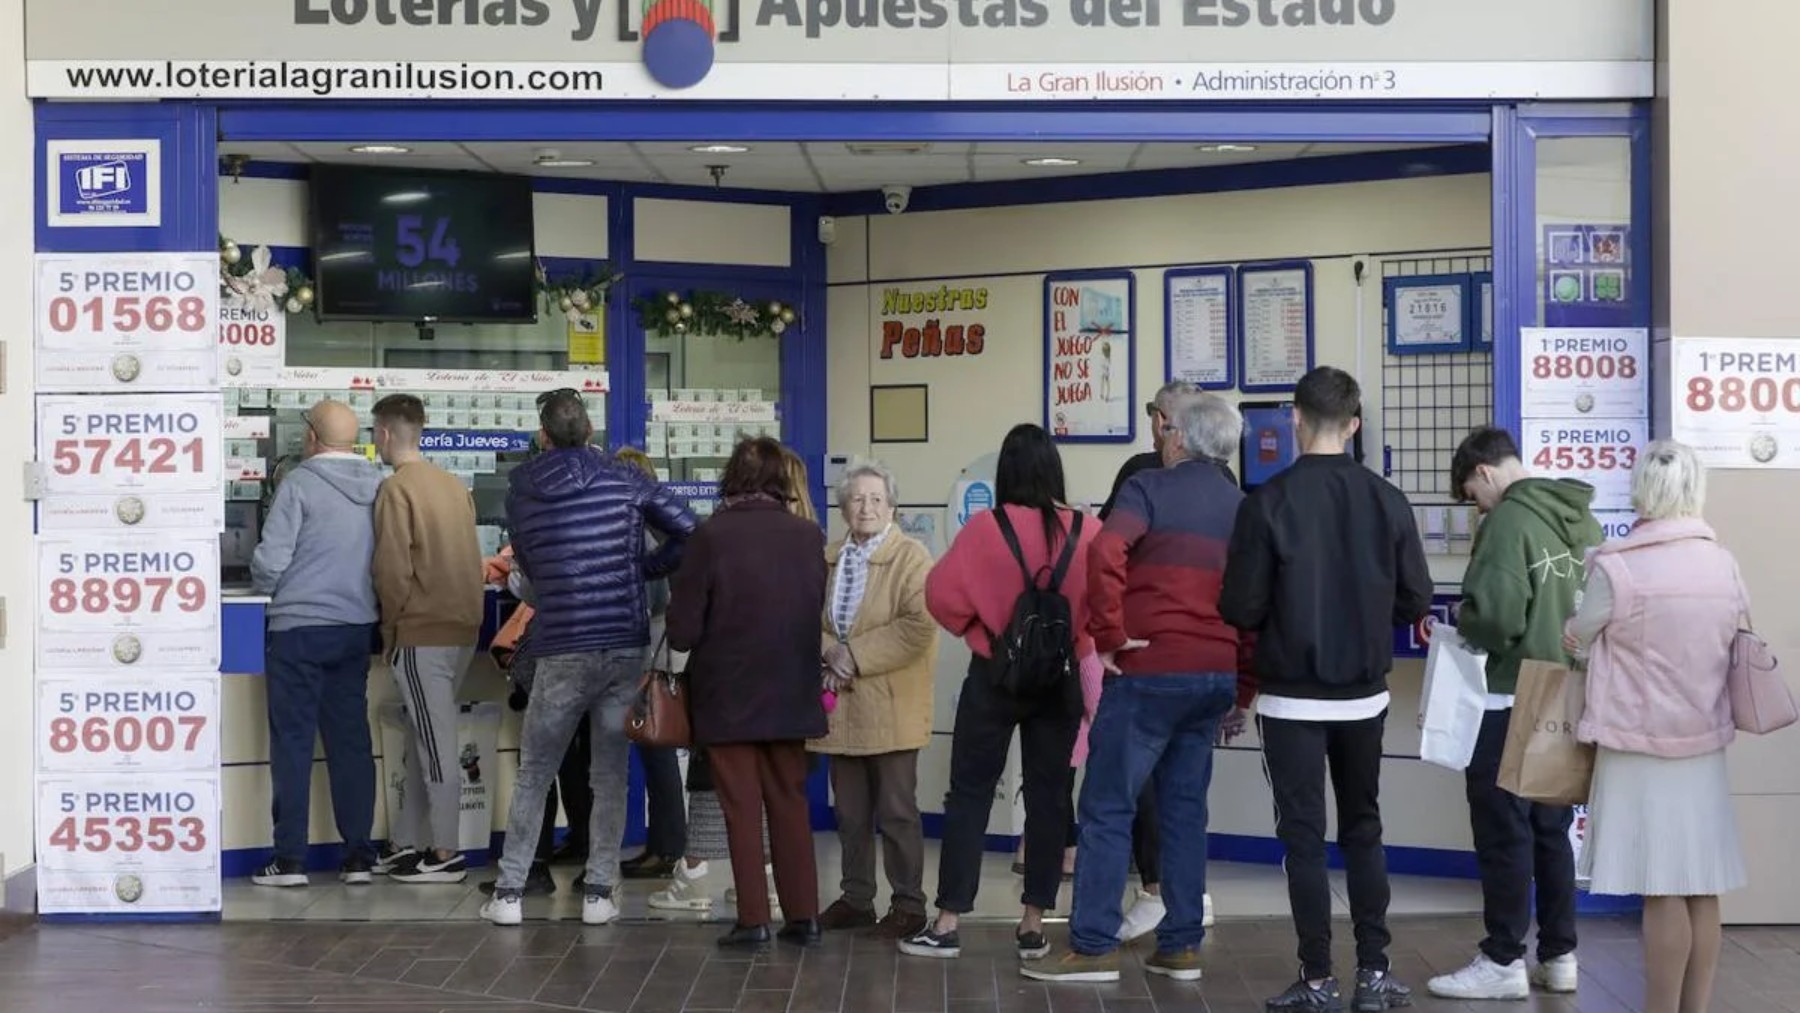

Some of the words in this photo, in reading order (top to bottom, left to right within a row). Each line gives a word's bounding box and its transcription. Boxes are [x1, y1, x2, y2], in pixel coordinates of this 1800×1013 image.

[571, 0, 601, 41] y
[755, 0, 1049, 38] Apuestas
[1070, 0, 1160, 26] del
[1182, 0, 1396, 26] Estado
[66, 62, 603, 95] www.loterialagranilusion.com
[1007, 72, 1032, 91] La
[1039, 72, 1089, 92] Gran
[1096, 71, 1164, 91] Ilusión
[1192, 71, 1353, 91] Administración
[1383, 72, 1397, 91] 3
[81, 167, 126, 190] IFI
[396, 213, 461, 267] 54
[85, 272, 195, 292] PREMIO
[378, 271, 478, 294] MILLONES
[881, 284, 987, 315] Nuestras
[1054, 286, 1079, 308] CON
[49, 296, 206, 332] 01568
[220, 309, 269, 321] REMIO
[1054, 311, 1067, 332] EL
[220, 324, 275, 346] 008
[880, 318, 985, 359] Peñas
[1056, 335, 1093, 357] JUEGO
[1555, 338, 1628, 352] PREMIO
[1054, 362, 1073, 381] NO
[1077, 358, 1090, 380] SE
[1533, 355, 1637, 379] 88008
[1720, 352, 1796, 372] PREM
[1055, 383, 1093, 406] JUEGA
[1686, 376, 1800, 412] 8800
[88, 413, 198, 434] PREMIO
[420, 434, 453, 447] tería
[456, 434, 508, 447] Jueves
[1558, 430, 1631, 443] PREMIO
[53, 438, 204, 475] 57421
[1533, 446, 1638, 470] 45353
[668, 486, 698, 496] ORTEO
[85, 552, 194, 573] PREMIO
[49, 577, 206, 613] 88979
[86, 692, 196, 713] PREMIO
[49, 716, 207, 753] 86007
[86, 792, 195, 812] PREMIO
[49, 816, 207, 852] 45353
